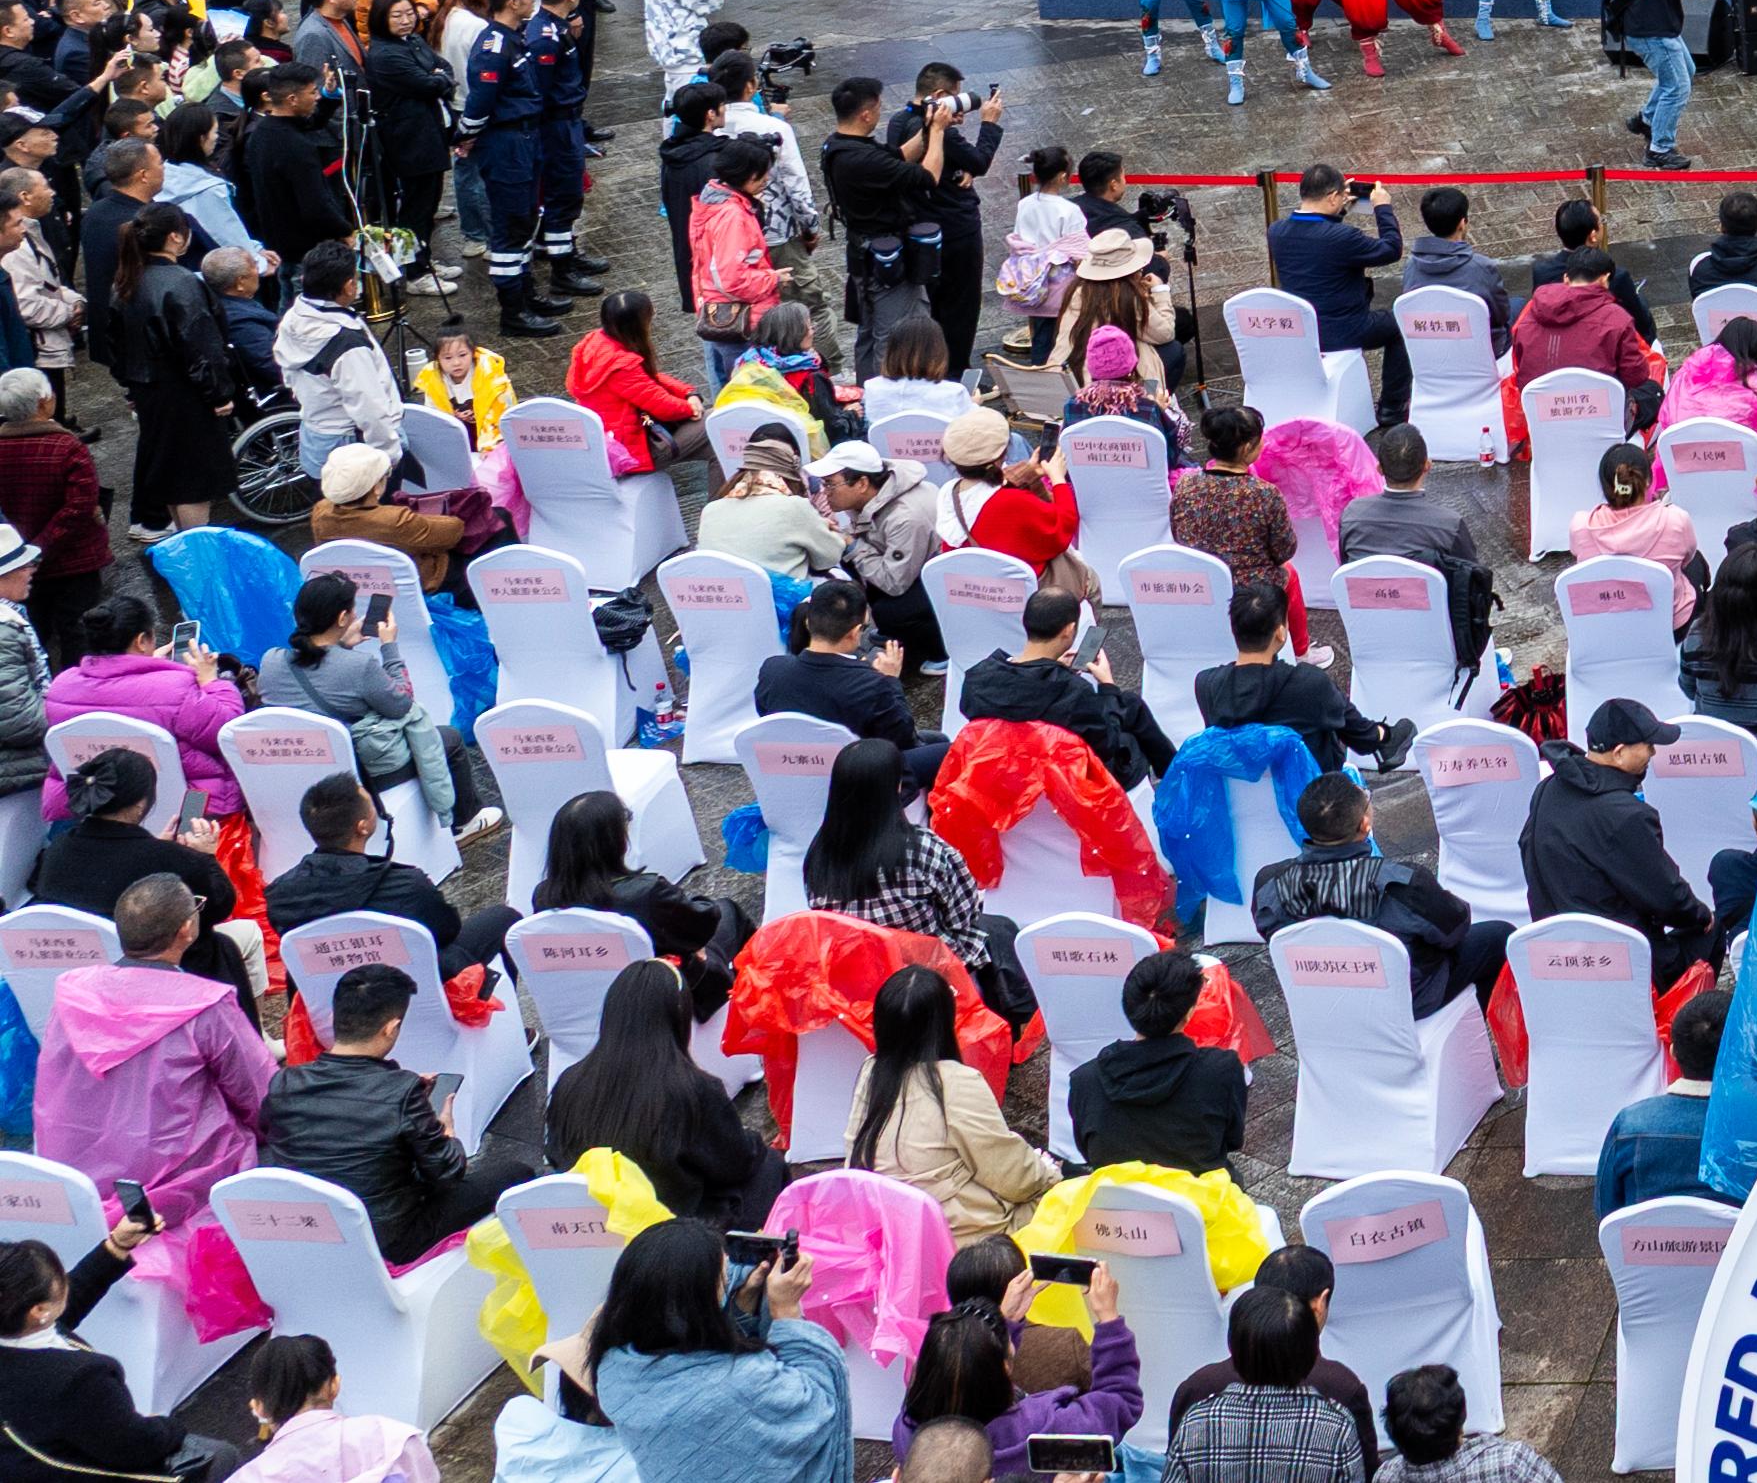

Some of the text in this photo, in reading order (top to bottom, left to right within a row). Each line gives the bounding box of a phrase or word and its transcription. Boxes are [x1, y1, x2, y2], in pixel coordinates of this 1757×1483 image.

[1554, 395, 1589, 404] 四川省
[1550, 406, 1598, 416] 旅游学会
[1073, 442, 1143, 451] 巴中农商银行
[1087, 453, 1132, 462] 南江支行
[1691, 450, 1726, 461] 人民网
[491, 586, 561, 595] 华人旅游业公会
[1140, 583, 1204, 594] 市旅游协会
[1375, 589, 1400, 599] 高德
[261, 738, 305, 746] 马来西亚
[513, 735, 556, 743] 马来西亚
[1438, 757, 1508, 772] 万寿养生谷
[1669, 753, 1727, 765] 恩阳古镇
[29, 938, 76, 946] 马来西亚
[314, 935, 384, 954] 通江银耳
[543, 946, 609, 958] 陈河耳乡
[1053, 951, 1118, 963] 唱歌石林
[330, 951, 381, 967] 博物馆
[1548, 956, 1611, 966] 云顶茶乡
[1295, 960, 1377, 973] 川陕苏区王坪
[246, 1214, 318, 1228] 三十二梁
[552, 1222, 607, 1234] 南天门
[1095, 1224, 1147, 1240] 佛头山
[1351, 1218, 1426, 1246] 白衣古镇
